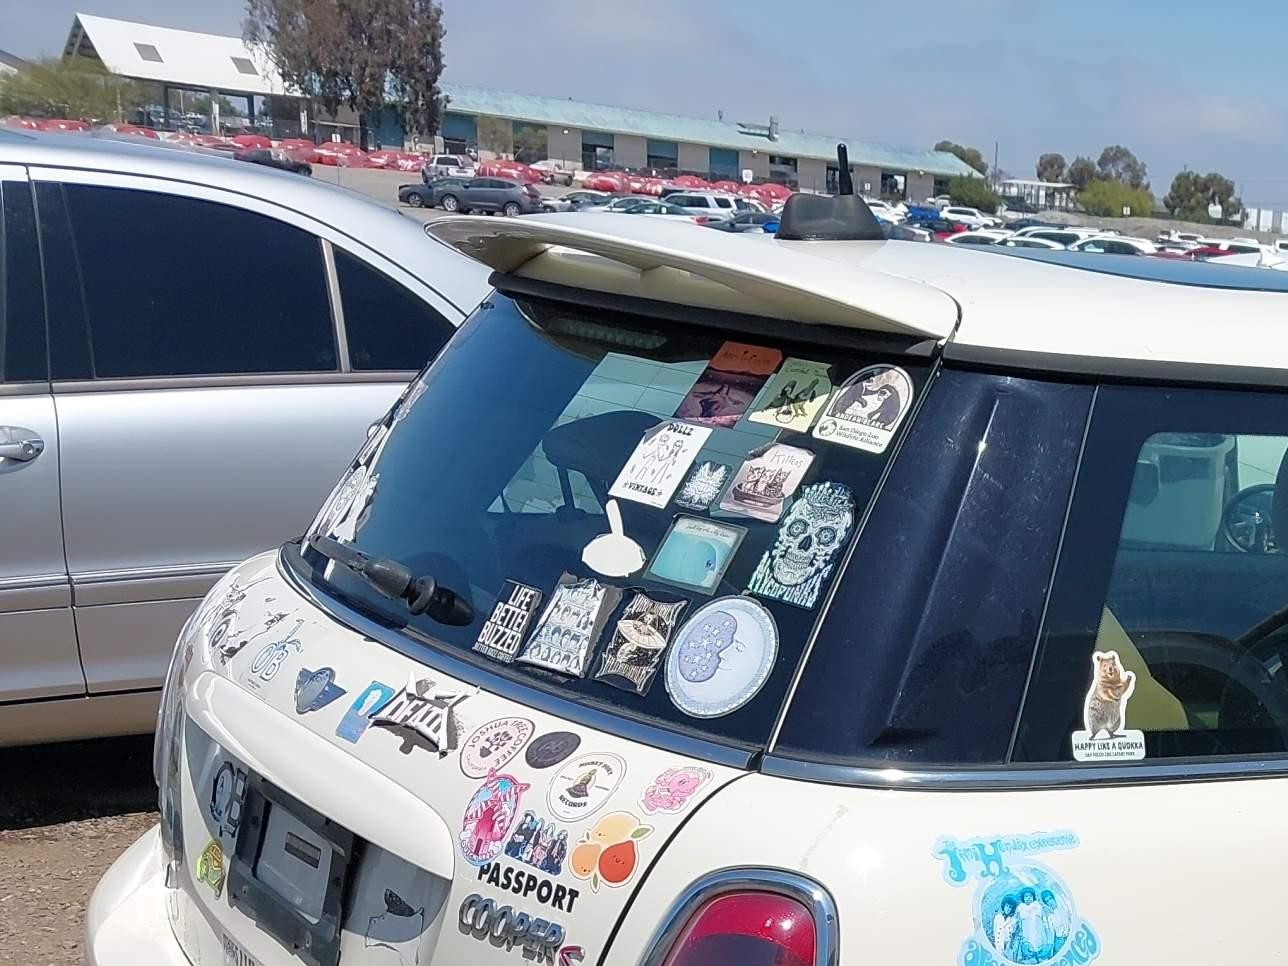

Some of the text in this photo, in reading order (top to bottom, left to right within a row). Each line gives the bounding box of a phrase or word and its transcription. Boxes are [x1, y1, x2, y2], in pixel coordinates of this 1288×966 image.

[508, 584, 537, 611] LIFE
[477, 620, 522, 655] BUZZED
[1074, 742, 1097, 750] HAPPY
[1097, 742, 1110, 750] LIKE
[1112, 742, 1117, 750] A
[477, 861, 580, 914] PASSPORT
